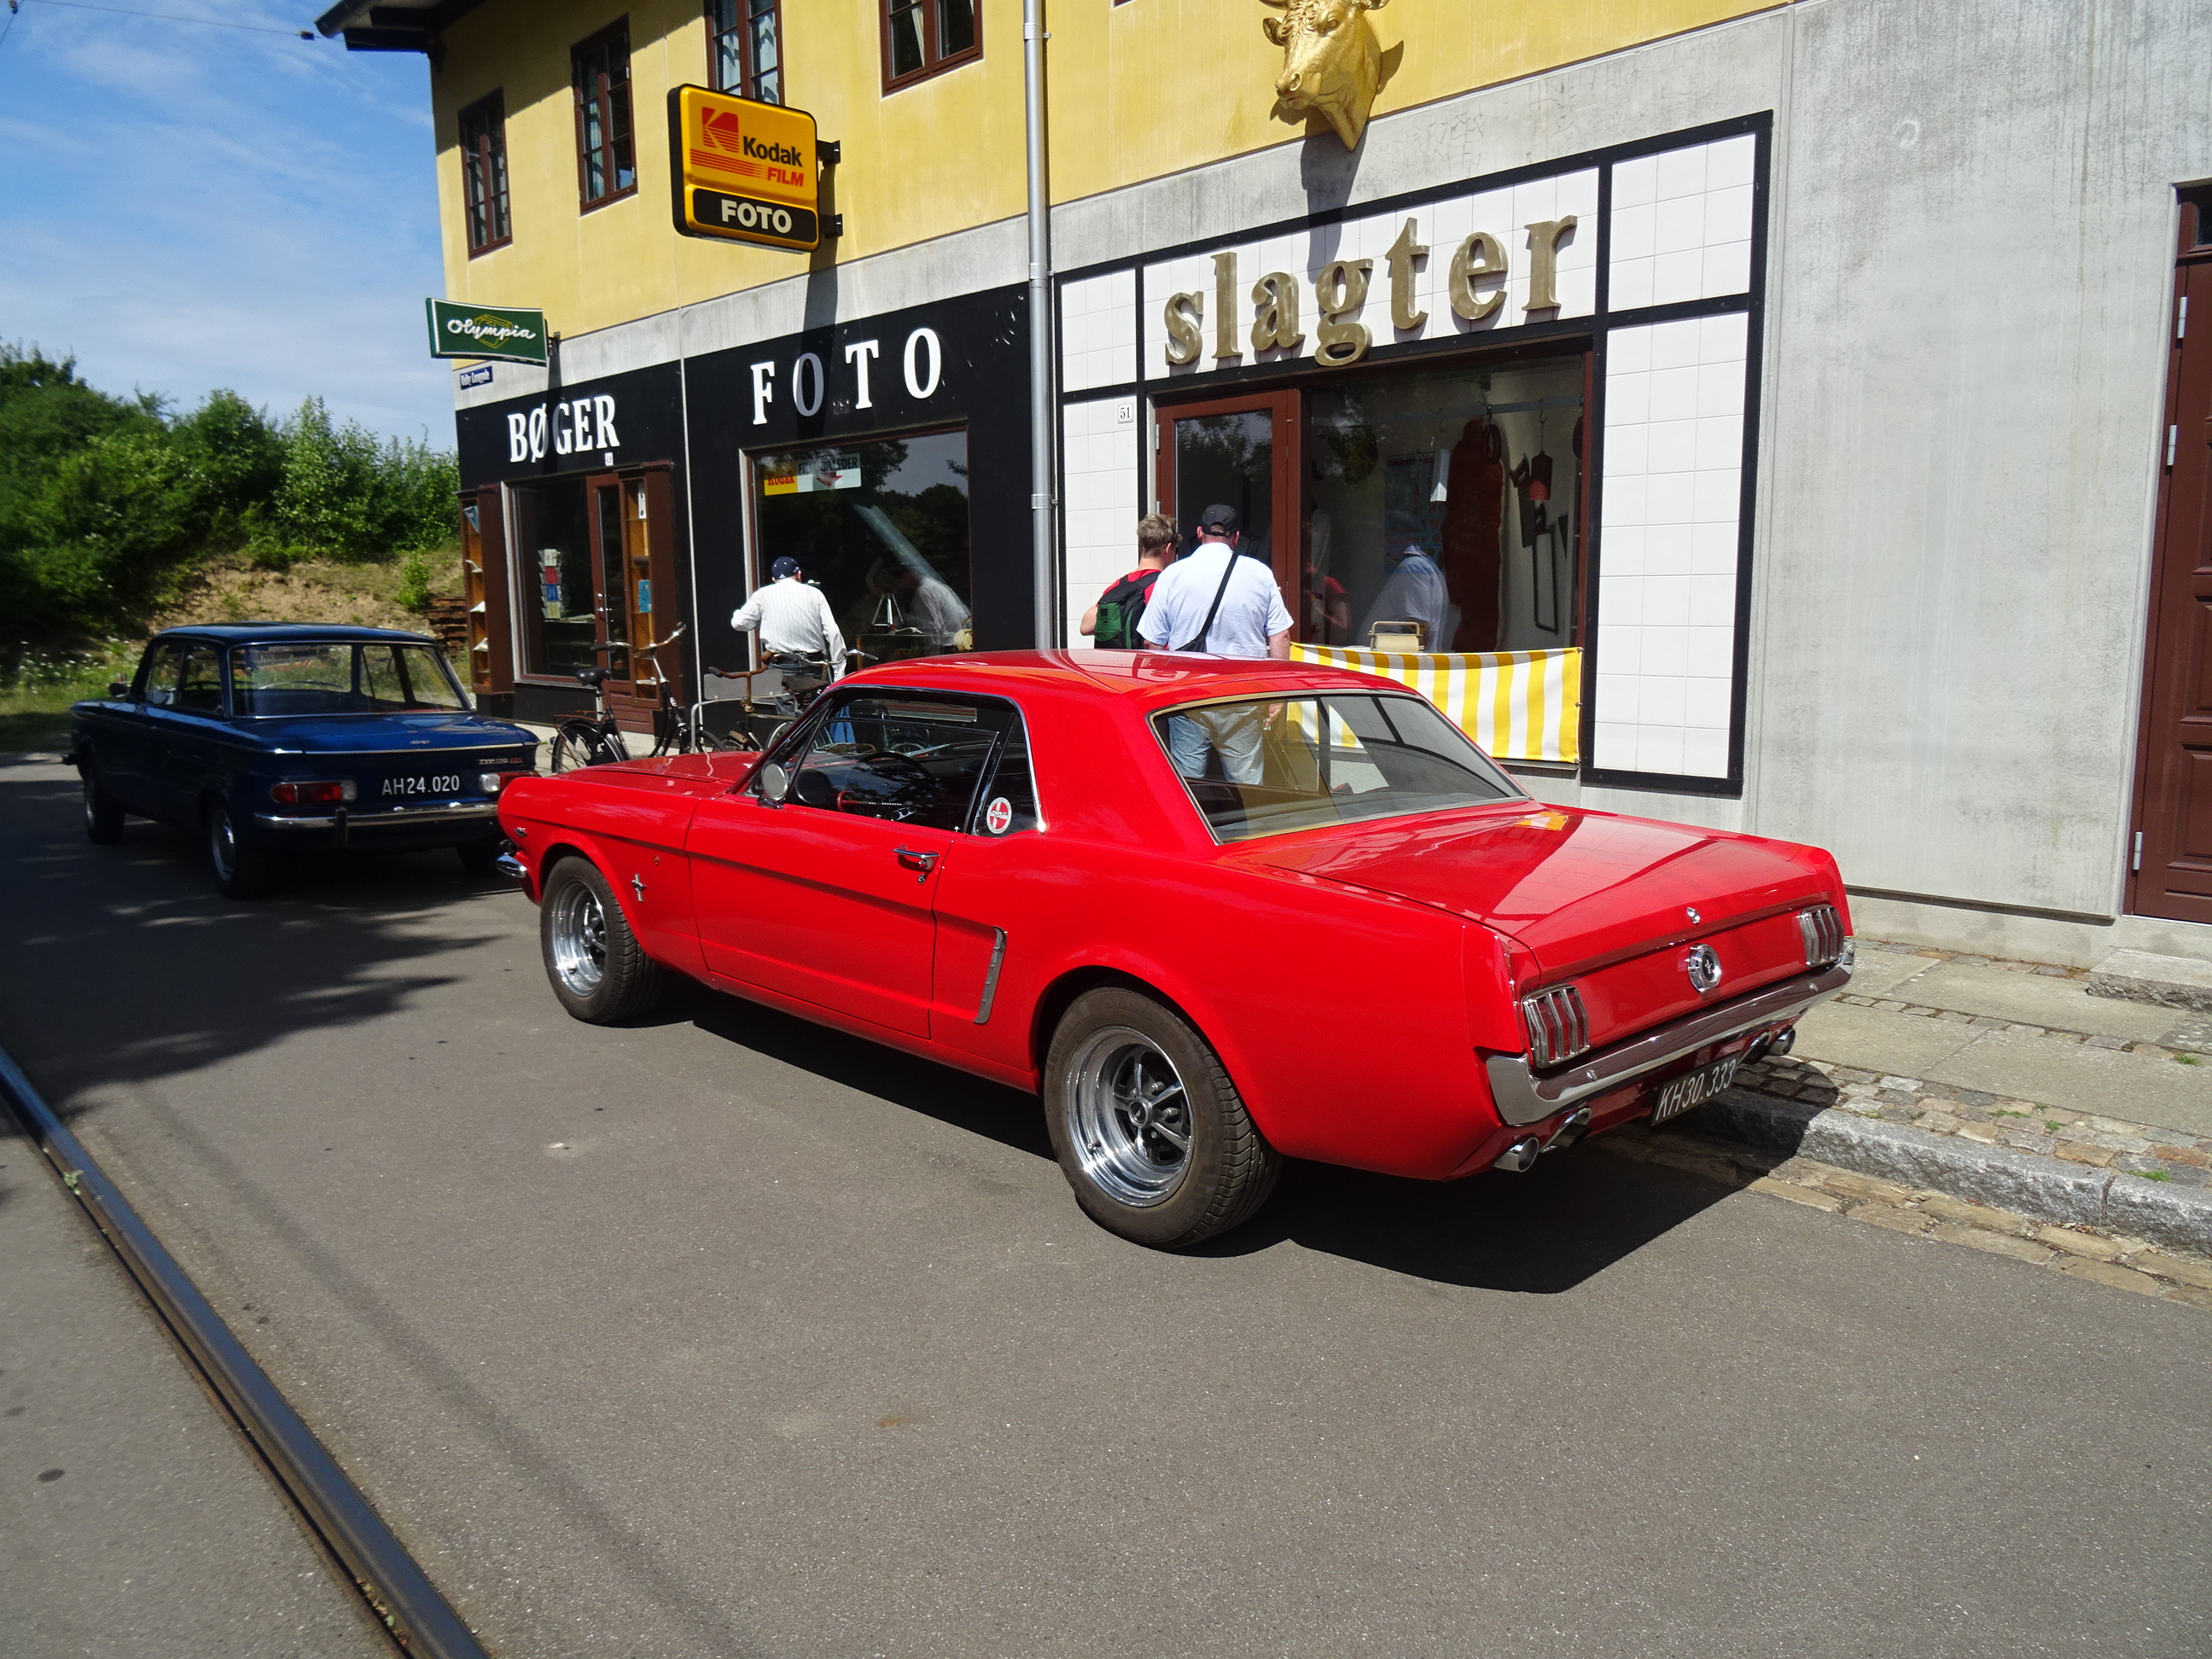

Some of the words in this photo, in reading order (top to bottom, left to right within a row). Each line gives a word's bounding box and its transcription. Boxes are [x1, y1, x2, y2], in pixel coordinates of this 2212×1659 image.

[743, 136, 803, 167] Kodak
[766, 166, 805, 188] FILM
[721, 199, 793, 234] FOTO
[1163, 214, 1577, 366] slagter
[446, 318, 537, 341] Olympia
[750, 328, 942, 425] FOTO
[507, 394, 620, 463] BØGER
[1120, 406, 1131, 420] 51
